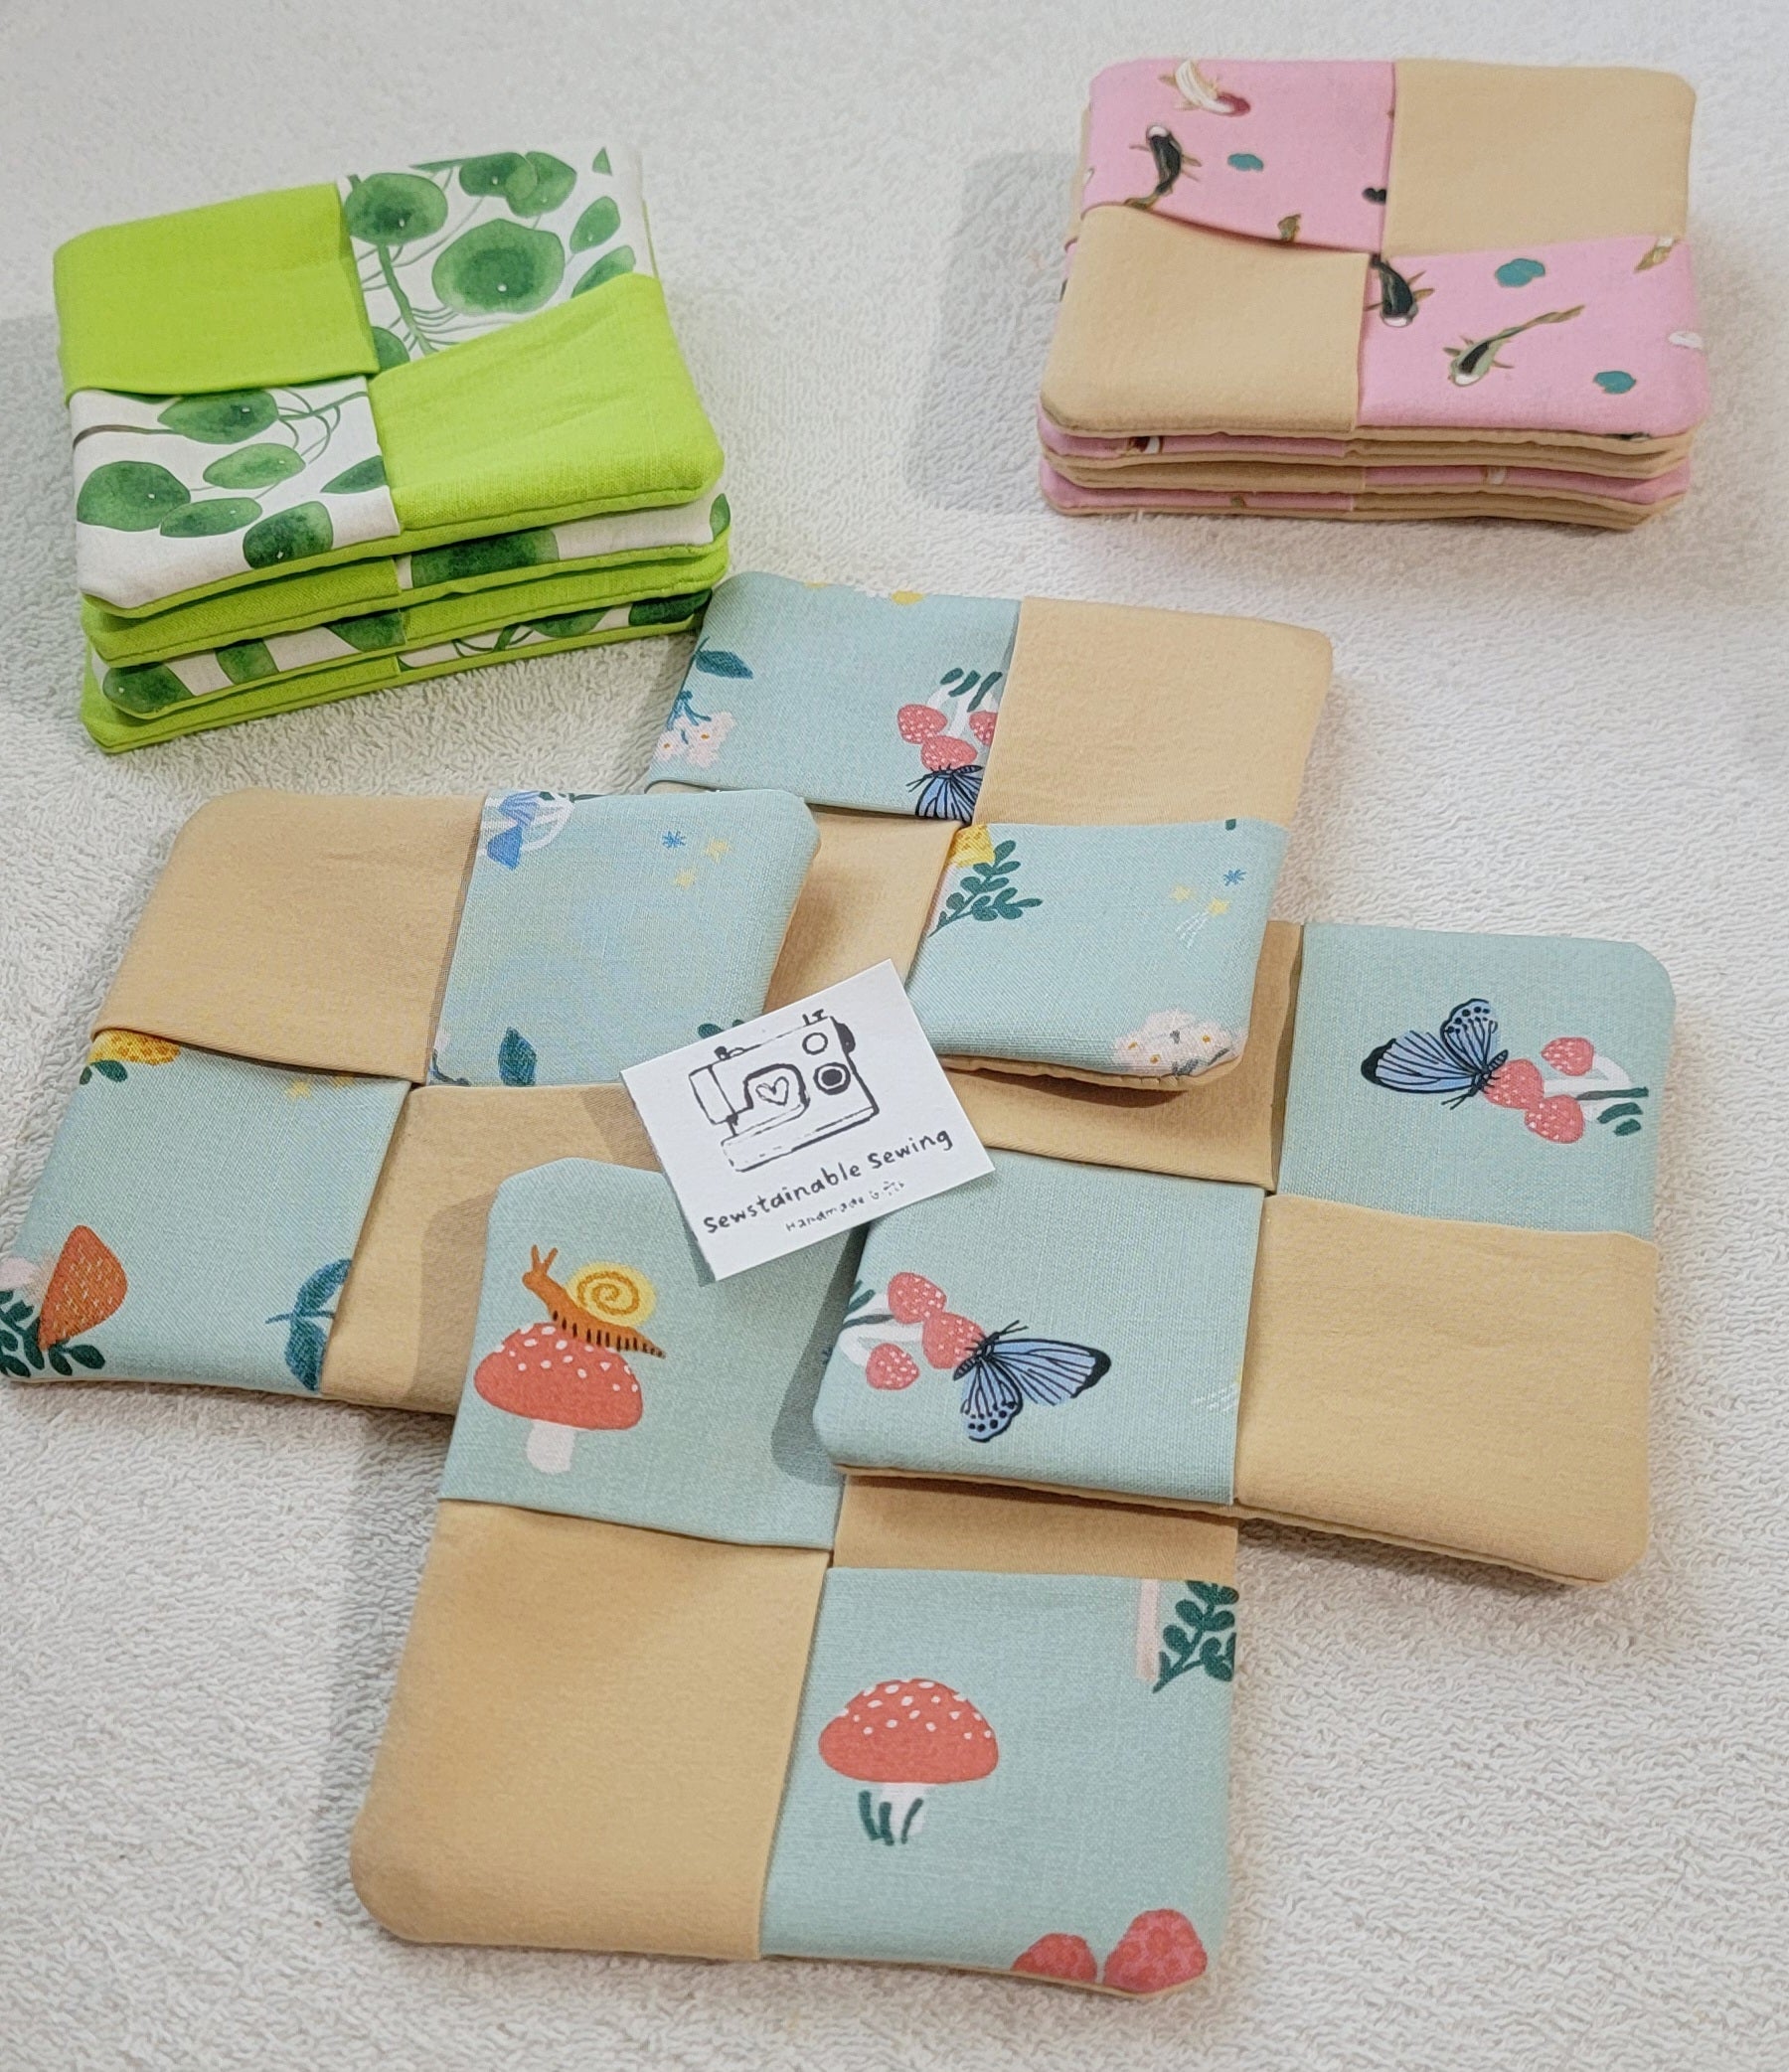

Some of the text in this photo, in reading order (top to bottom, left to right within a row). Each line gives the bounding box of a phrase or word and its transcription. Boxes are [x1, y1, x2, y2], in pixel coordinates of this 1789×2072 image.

[703, 1129, 953, 1233] Sewstainable Sewing
[786, 1195, 866, 1231] Handmade
